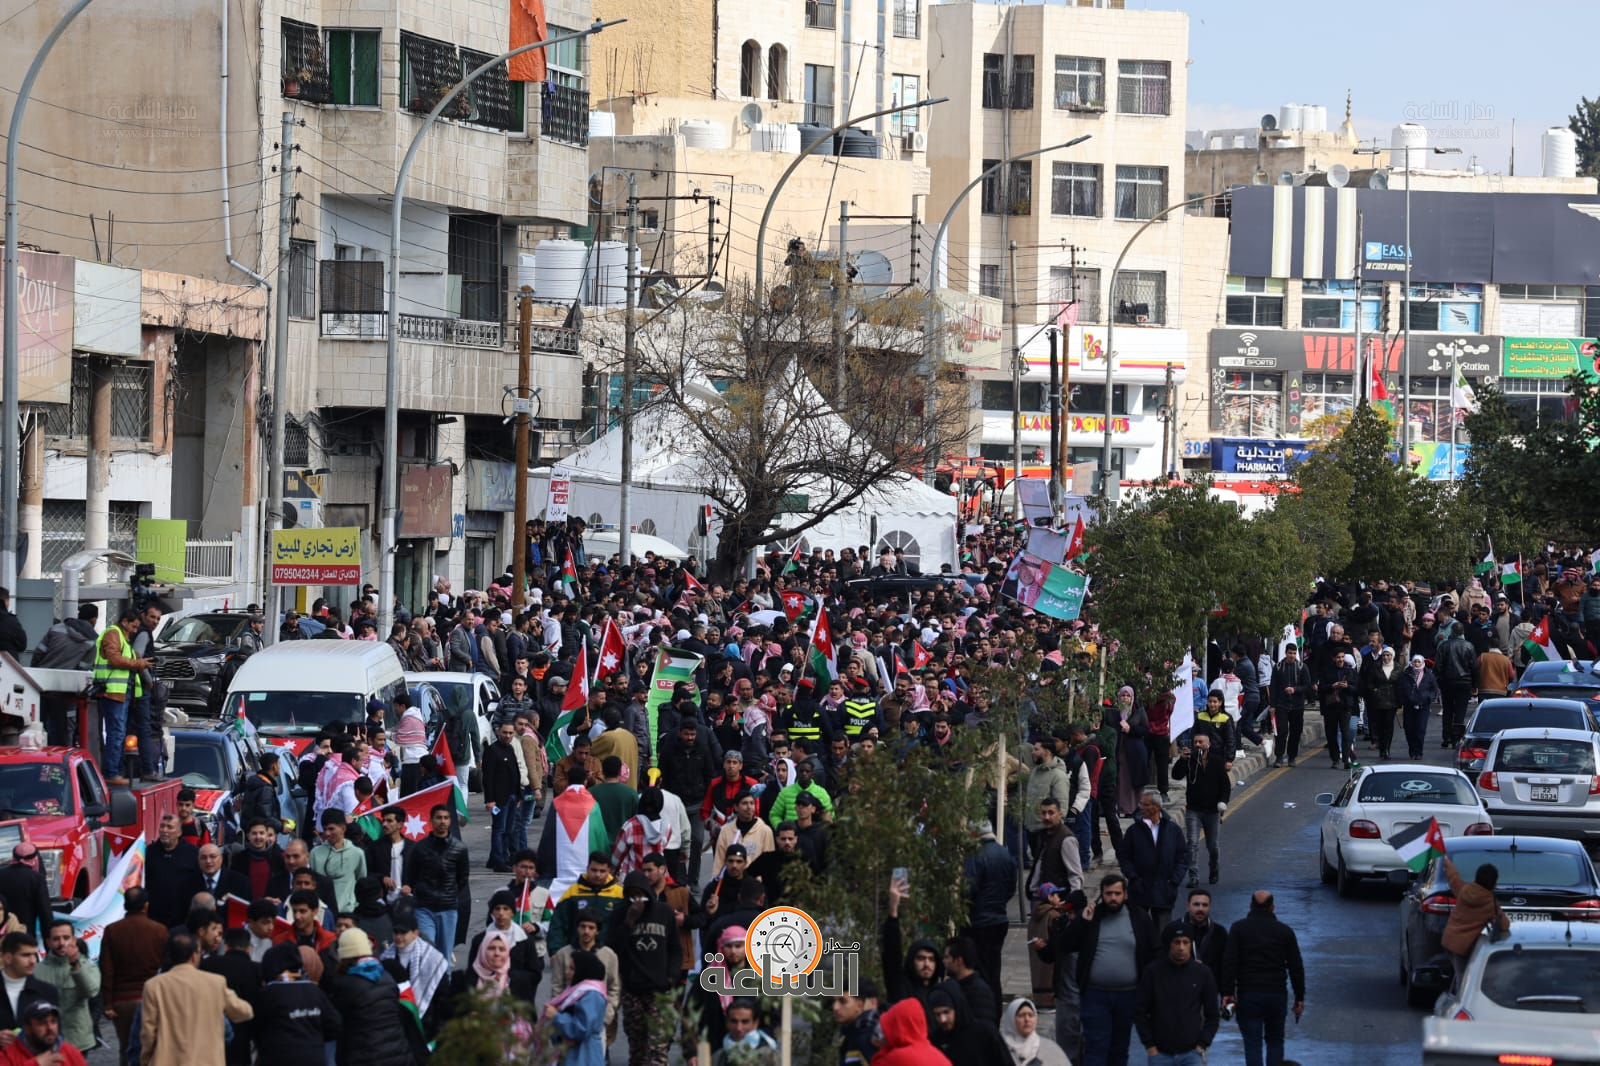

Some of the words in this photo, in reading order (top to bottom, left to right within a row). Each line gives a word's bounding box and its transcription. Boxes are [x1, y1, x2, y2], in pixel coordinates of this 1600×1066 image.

[1184, 441, 1210, 455] 309
[1237, 446, 1283, 461] صيدلية
[1237, 463, 1281, 472] PHARMACY
[277, 538, 300, 560] للبيع
[303, 539, 333, 559] تجاري
[336, 536, 356, 557] أرض
[275, 568, 319, 580] 0795042344
[320, 569, 338, 581] للعقار
